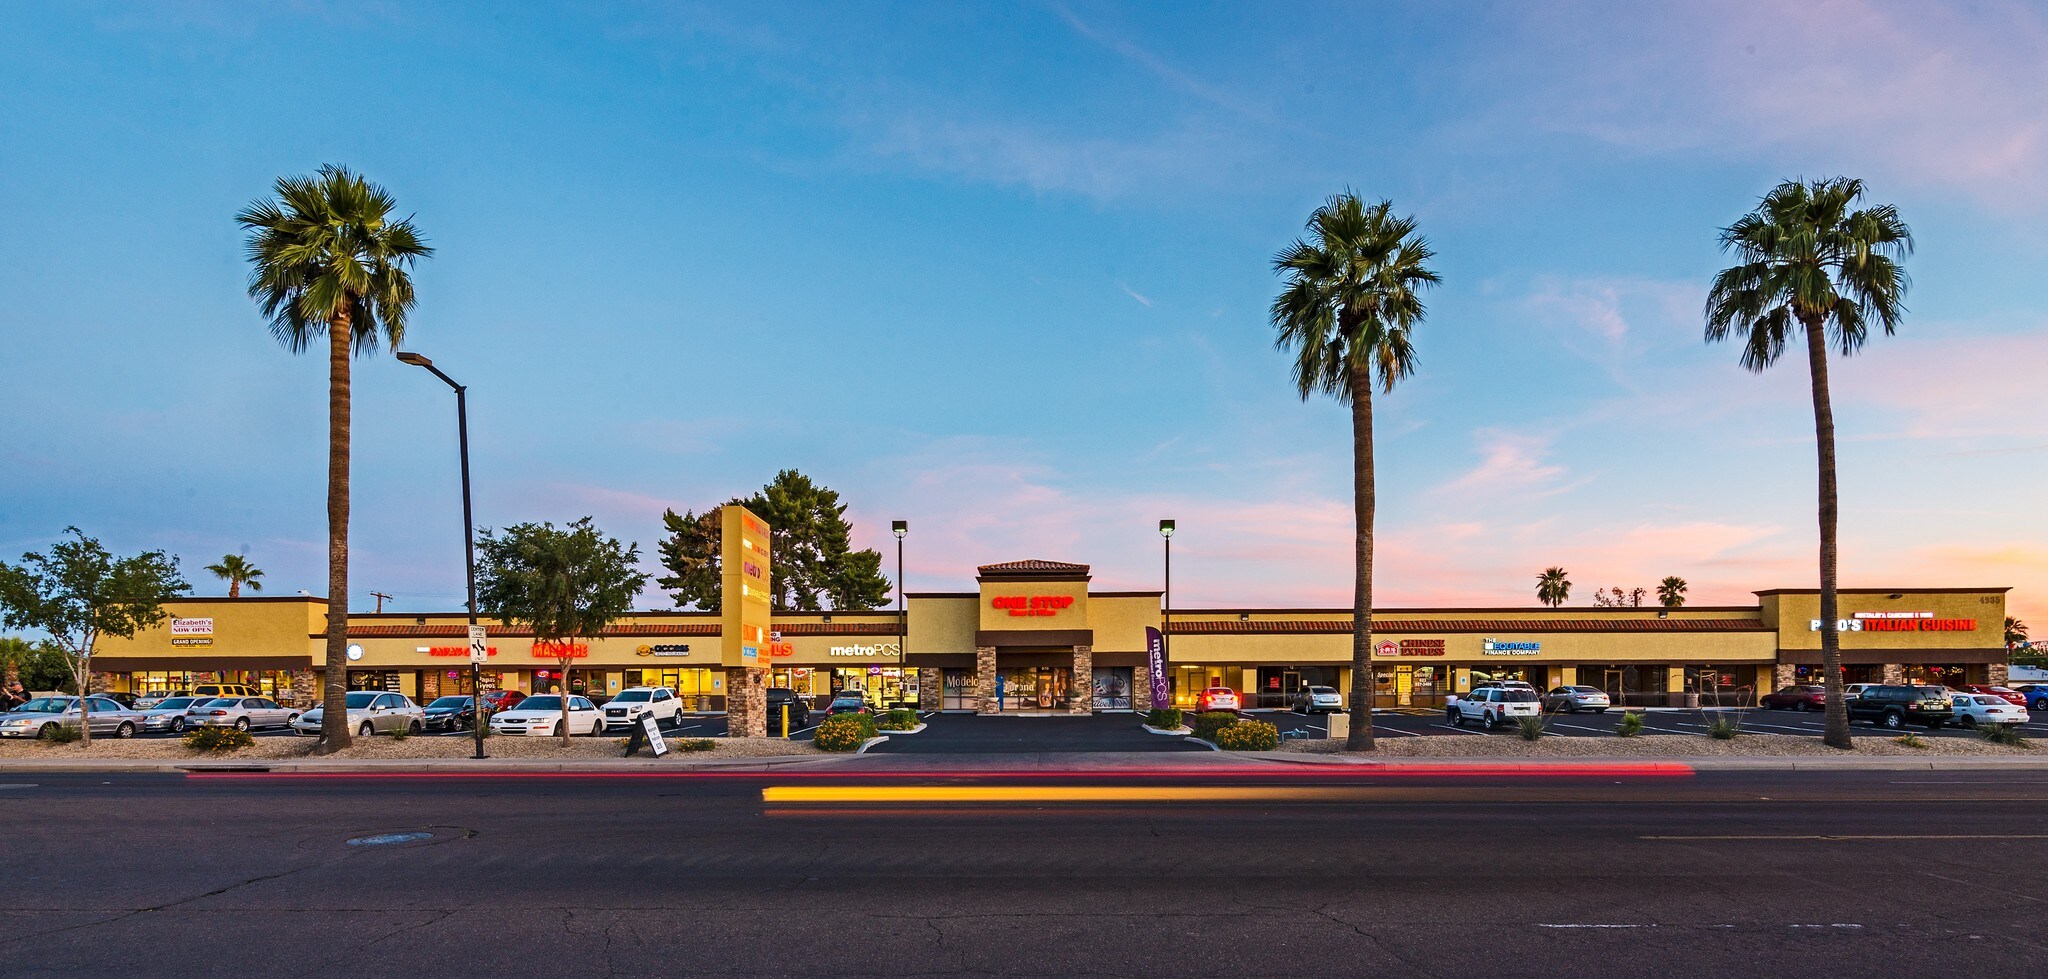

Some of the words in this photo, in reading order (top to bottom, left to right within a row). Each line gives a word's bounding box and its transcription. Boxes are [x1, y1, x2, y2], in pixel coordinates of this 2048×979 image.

[993, 595, 1027, 609] ONE
[1031, 595, 1075, 609] STOP
[1979, 596, 2000, 604] 4935
[1810, 619, 1862, 631] PO'S
[1863, 619, 1919, 631] ITALIAN
[1921, 619, 1978, 631] CUISINE
[1400, 639, 1446, 648] CHINESE
[1493, 642, 1541, 650] EQUITABLE
[830, 643, 900, 657] metroPCS
[1400, 647, 1446, 656] EXPRESS
[1153, 638, 1168, 701] metroPCS
[946, 675, 979, 688] Modelo
